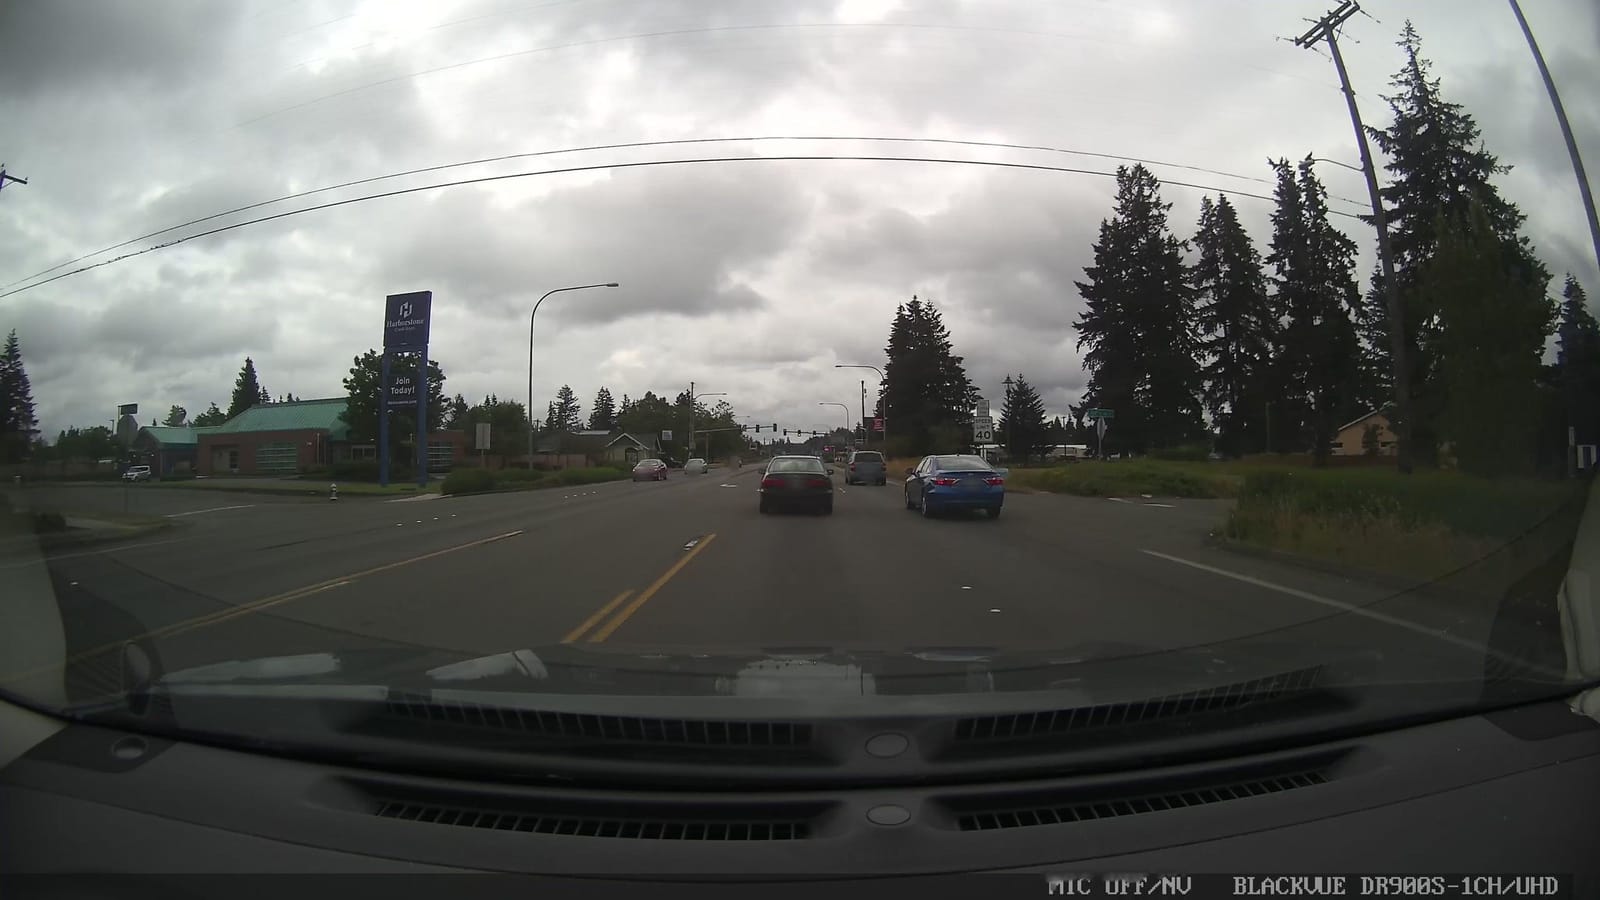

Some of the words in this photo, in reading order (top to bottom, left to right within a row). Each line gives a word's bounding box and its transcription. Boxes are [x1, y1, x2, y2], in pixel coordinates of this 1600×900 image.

[395, 376, 410, 384] Join
[391, 386, 415, 395] Today!
[975, 430, 991, 440] 40
